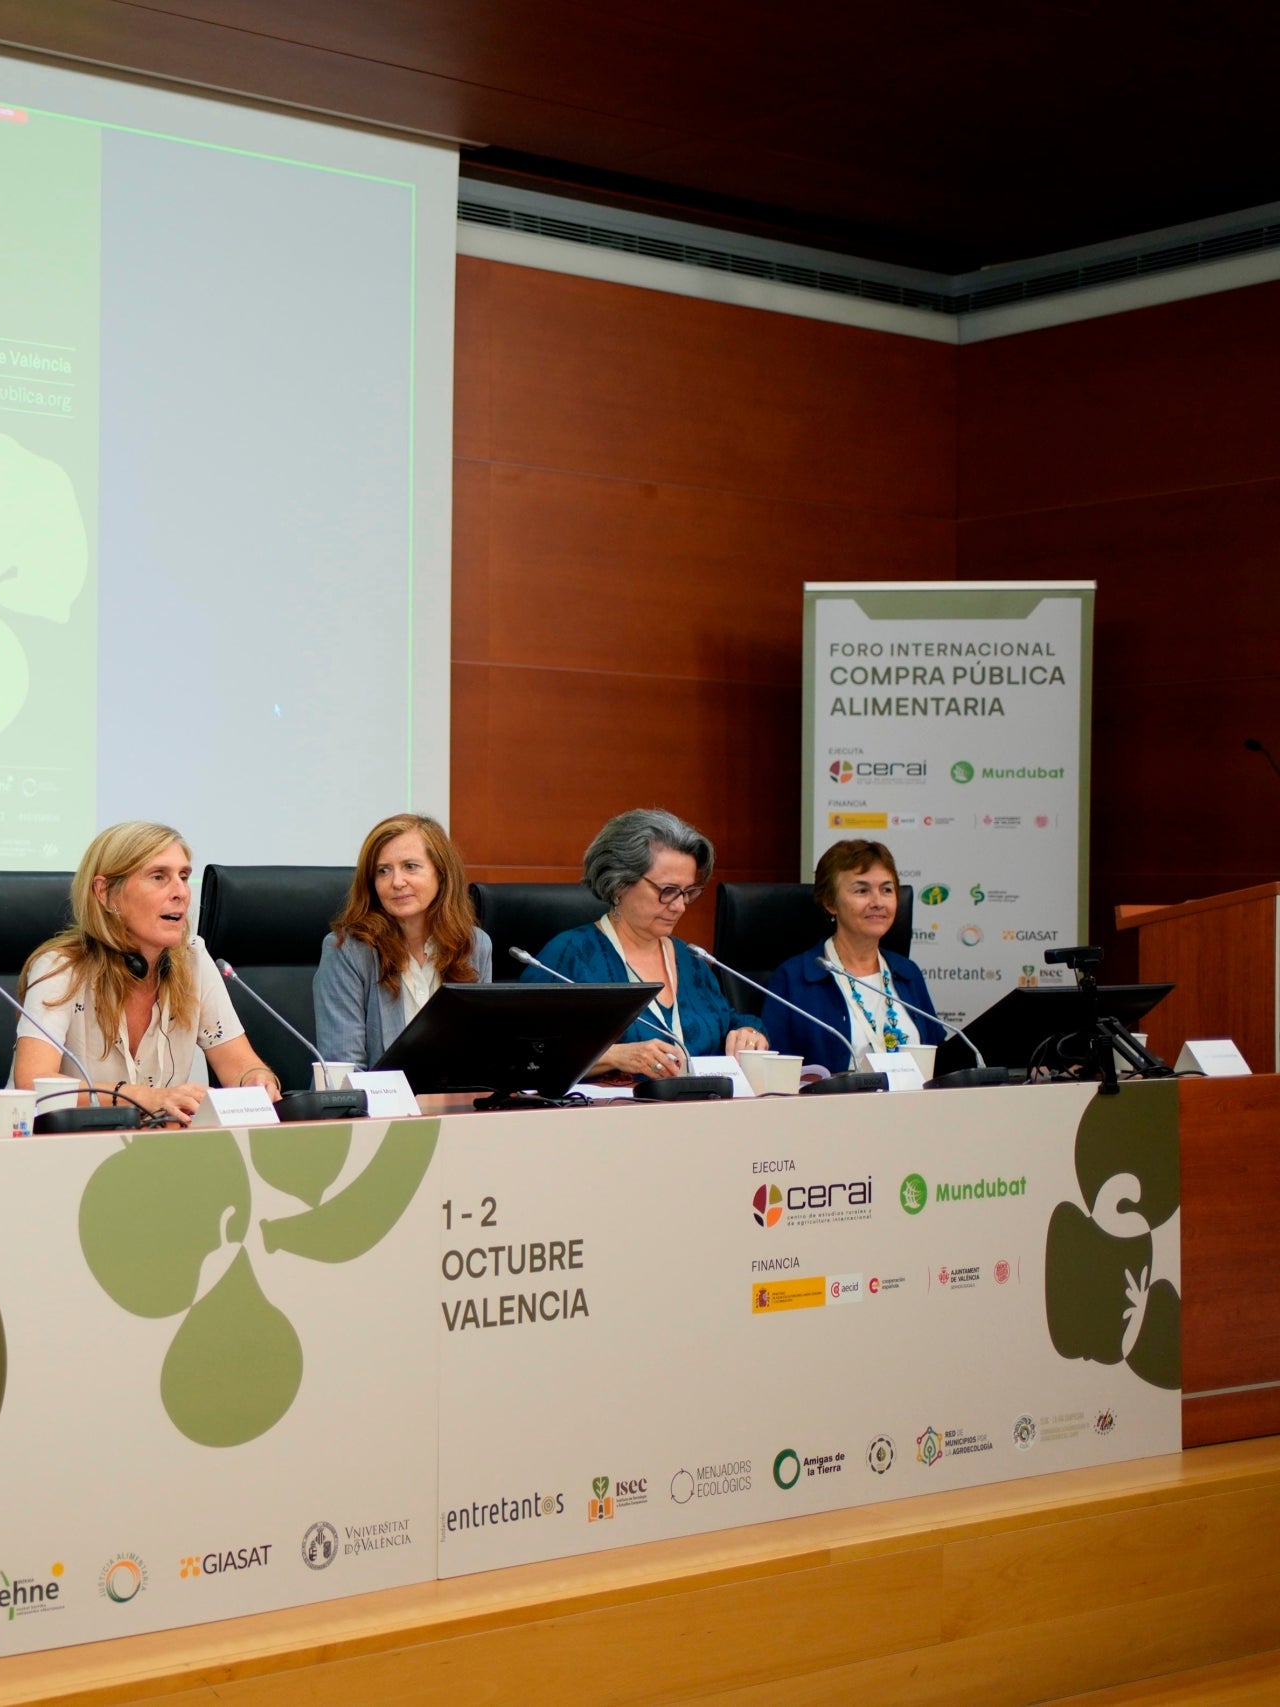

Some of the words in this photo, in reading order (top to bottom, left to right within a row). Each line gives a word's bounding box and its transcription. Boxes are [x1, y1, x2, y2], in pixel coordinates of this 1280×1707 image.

[10, 349, 72, 374] València
[830, 643, 884, 657] FORO
[890, 642, 1056, 657] INTERNACIONAL
[830, 666, 945, 686] COMPRA
[953, 661, 1066, 686] PÚBLICA
[830, 697, 1005, 717] ALIMENTARIA
[828, 748, 864, 756] EJECUTA
[856, 760, 927, 776] cerai
[982, 767, 1065, 779] Mundubat
[1016, 930, 1059, 941] GIASAT
[752, 1160, 796, 1174] EJECUTA
[787, 1176, 872, 1210] cerai
[936, 1176, 1026, 1202] Mundubat
[442, 1239, 584, 1281] OCTUBRE
[752, 1256, 800, 1272] FINANCIA
[950, 1267, 980, 1276] AJUNTAMENT
[842, 1281, 859, 1293] aecid
[441, 1288, 589, 1332] VALENCIA
[945, 1430, 956, 1438] RED
[945, 1435, 976, 1447] MUNICIPIOS
[804, 1455, 833, 1467] Amigas
[835, 1452, 845, 1462] de
[696, 1460, 752, 1480] MENJADORS
[807, 1468, 815, 1476] la
[817, 1464, 842, 1475] Tierra
[697, 1476, 752, 1498] ECOLÒGICS
[447, 1492, 564, 1532] entretantos
[202, 1545, 272, 1575] GIASAT
